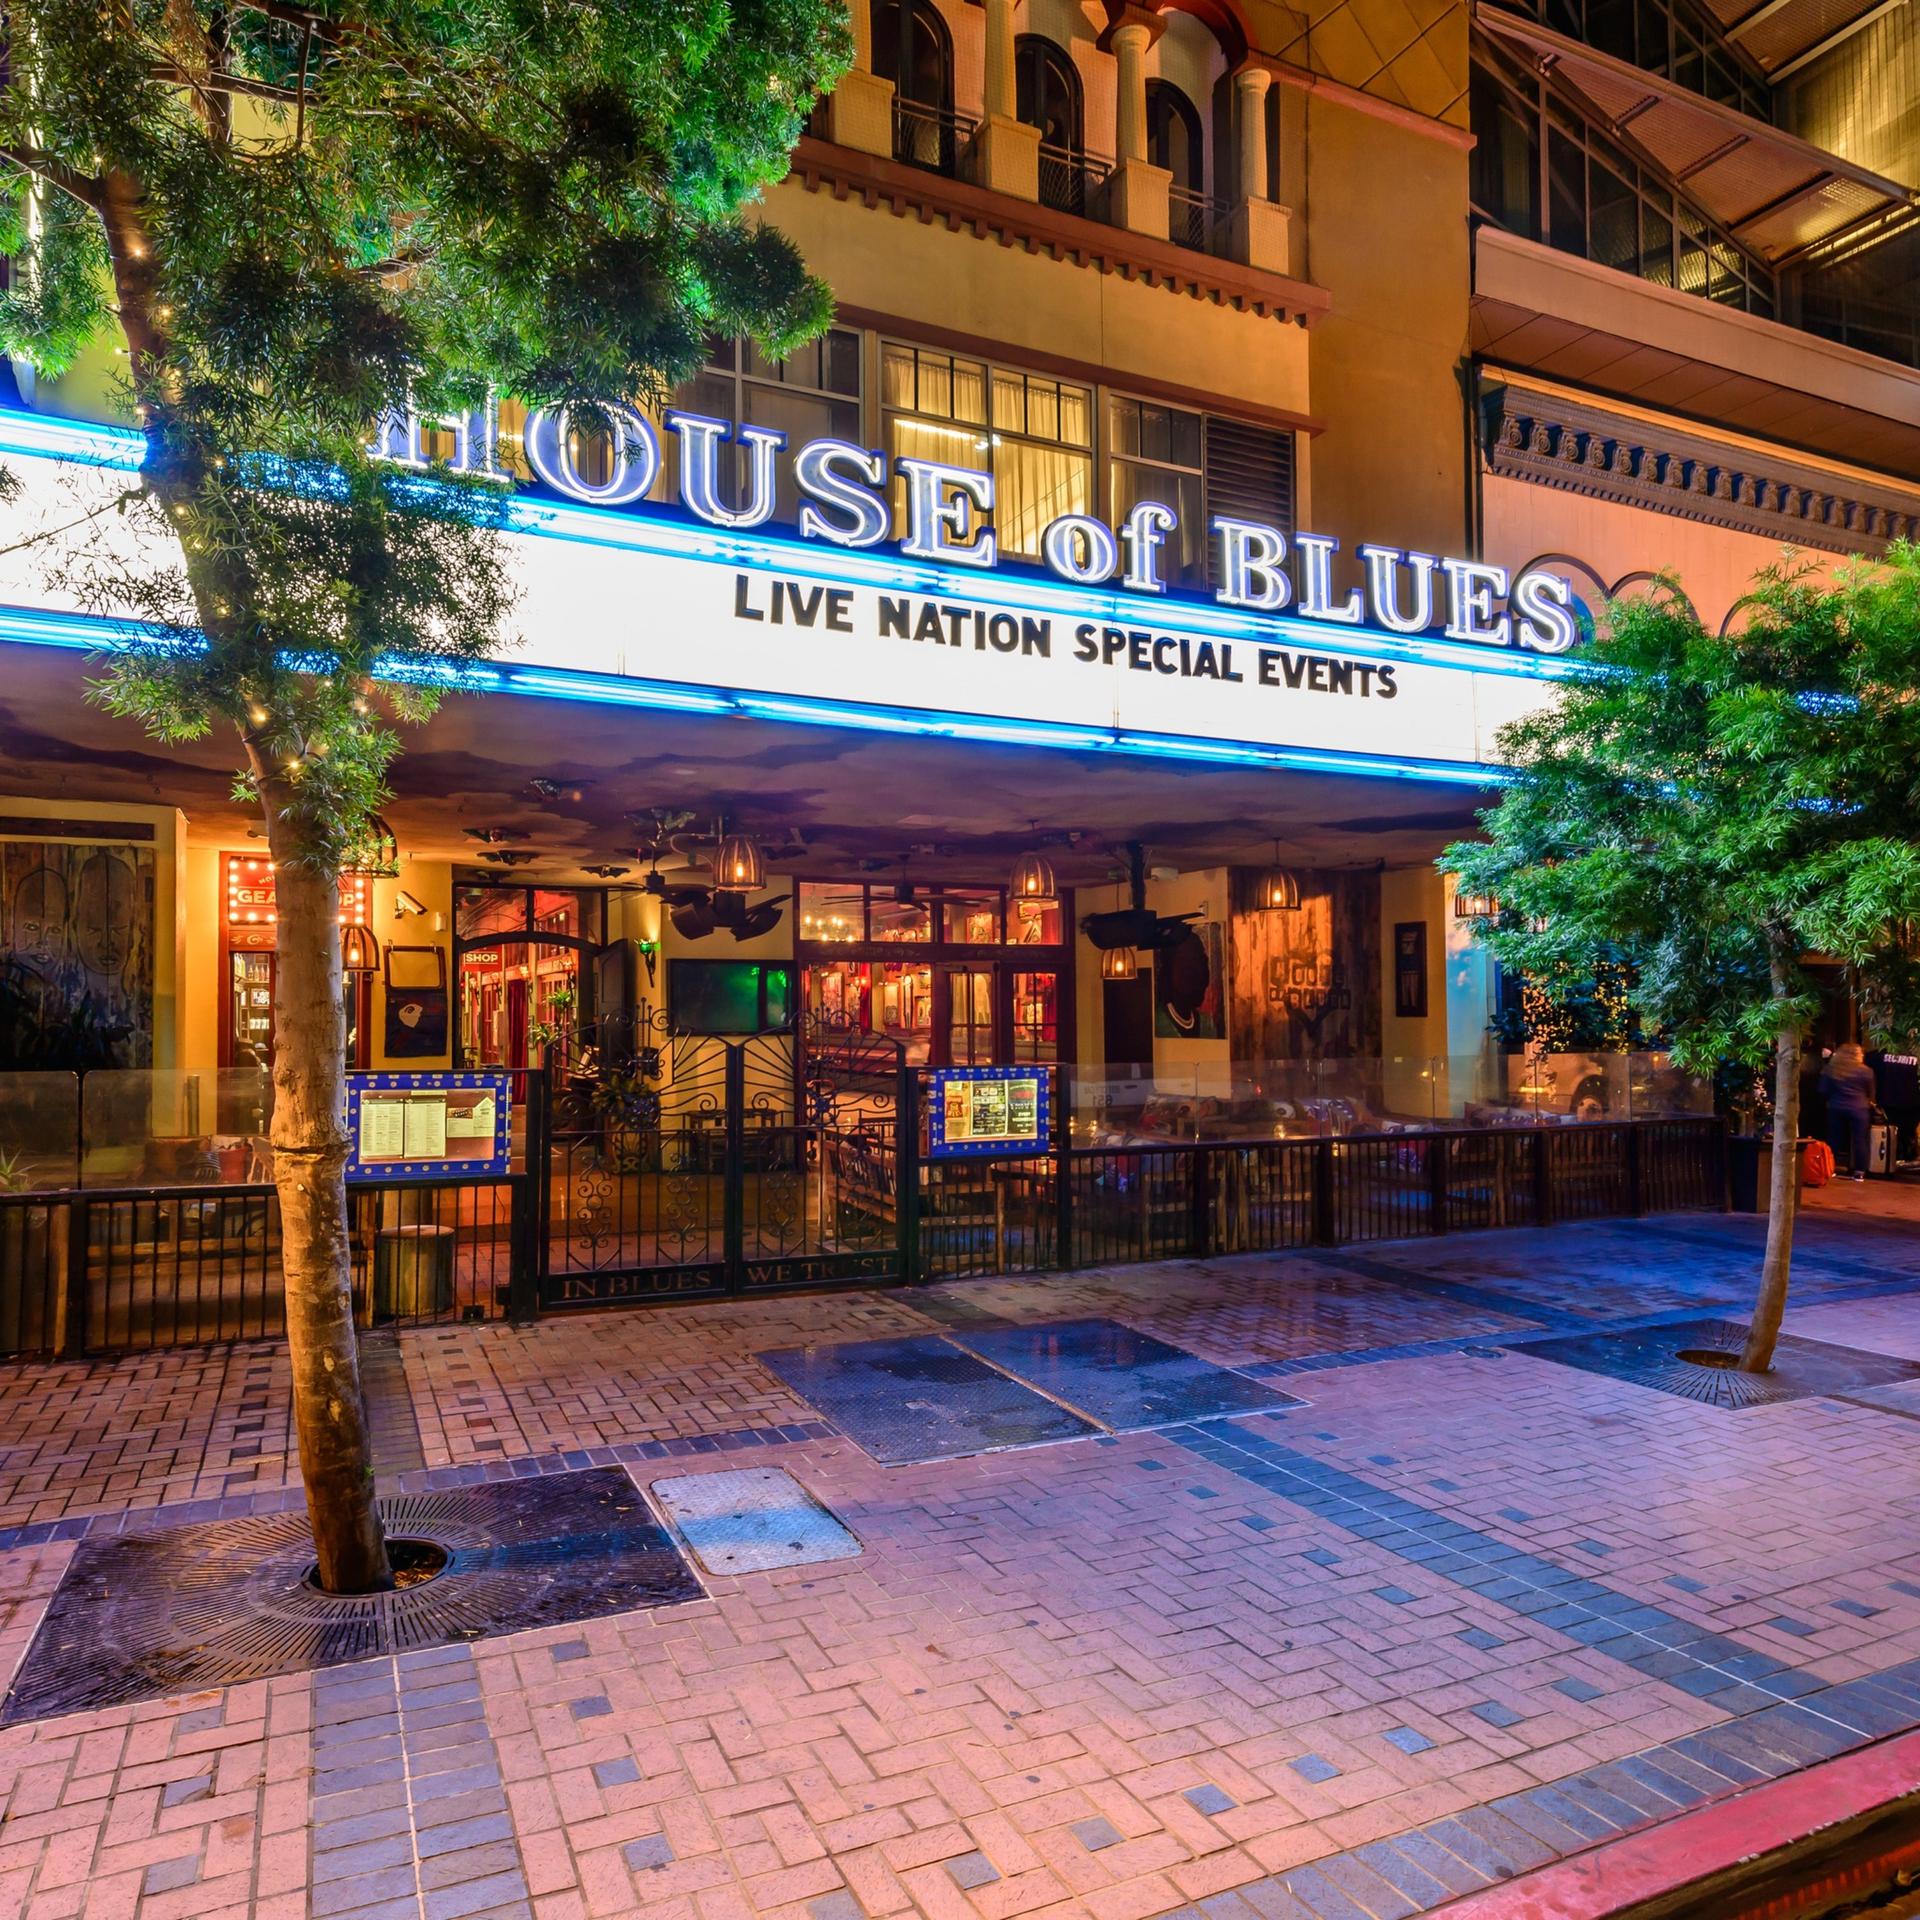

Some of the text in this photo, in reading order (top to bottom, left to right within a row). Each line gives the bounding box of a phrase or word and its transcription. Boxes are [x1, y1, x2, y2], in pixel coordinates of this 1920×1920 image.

[364, 362, 1578, 655] HOUSE of BLUES
[734, 573, 1398, 699] LIVE NATION SPECIAL EVENTS
[237, 889, 277, 905] GEA
[466, 953, 498, 962] SHOP
[1883, 1053, 1918, 1066] SECURITY
[563, 1278, 596, 1299] IN
[608, 1270, 712, 1296] BLUES
[748, 1262, 794, 1284] WE
